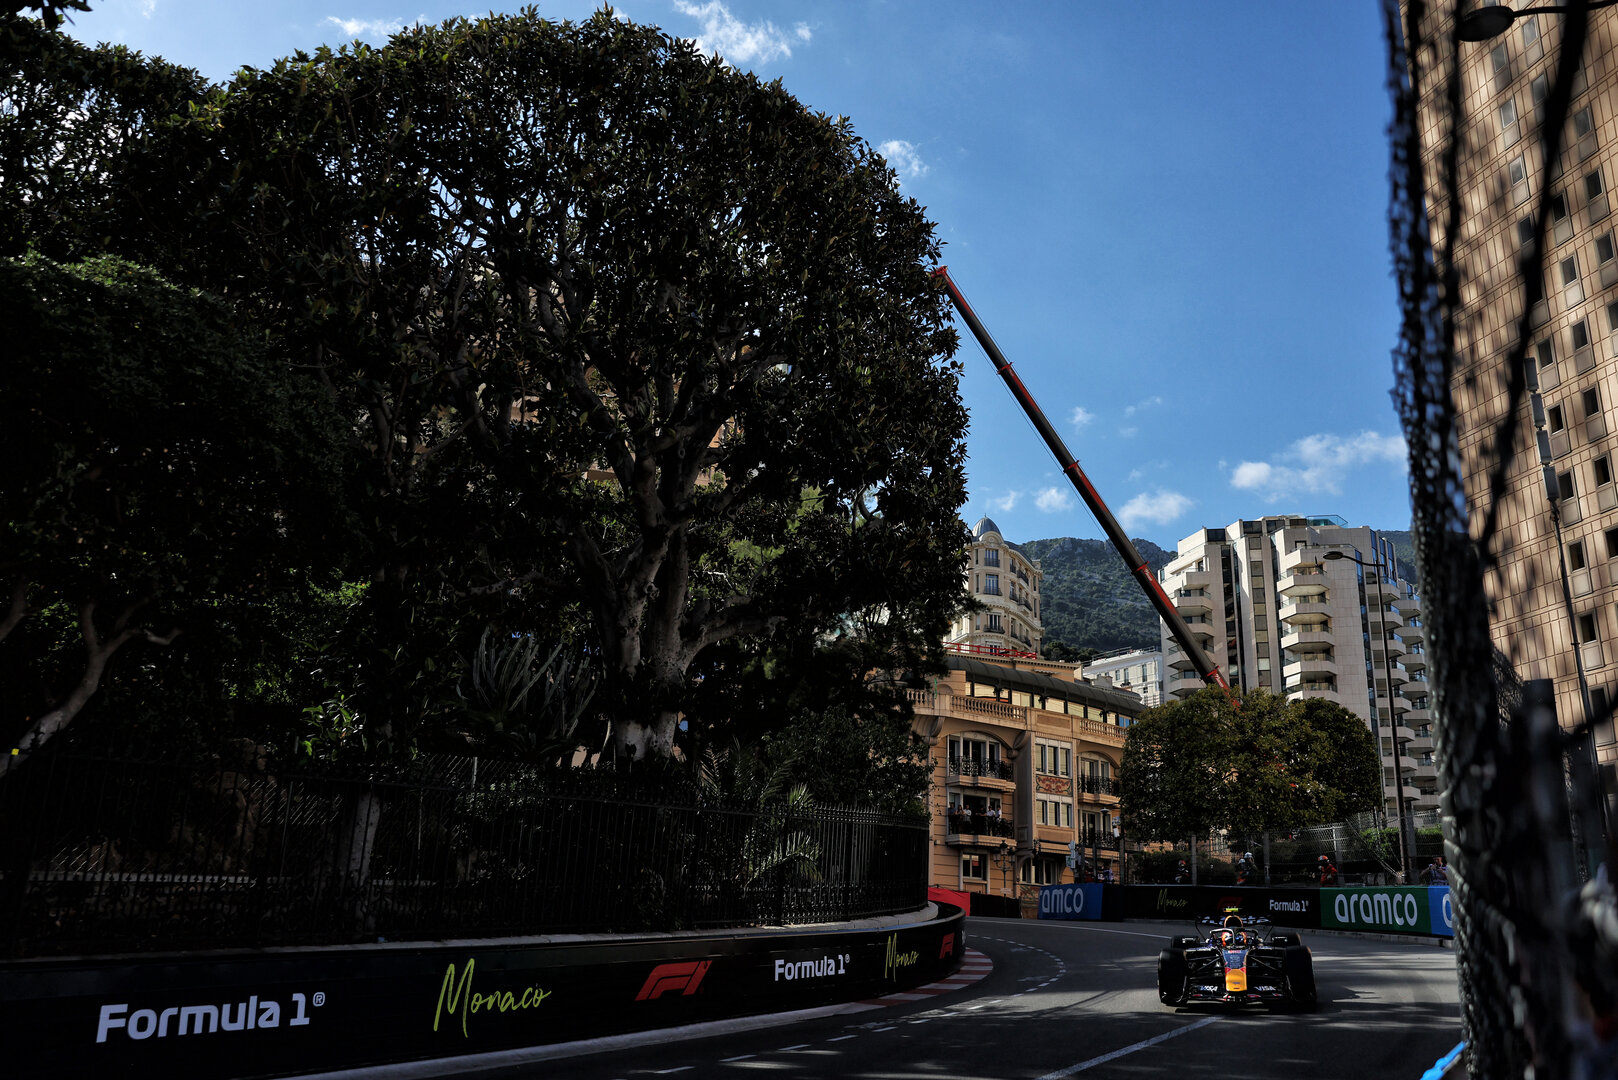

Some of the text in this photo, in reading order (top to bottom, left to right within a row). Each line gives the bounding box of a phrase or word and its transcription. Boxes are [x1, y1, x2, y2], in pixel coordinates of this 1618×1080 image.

[1269, 899, 1301, 912] Formula
[1334, 893, 1418, 926] aramco
[774, 955, 836, 982] Formula
[884, 932, 920, 983] Monaco
[433, 957, 552, 1038] Monaco
[95, 994, 281, 1043] Formula
